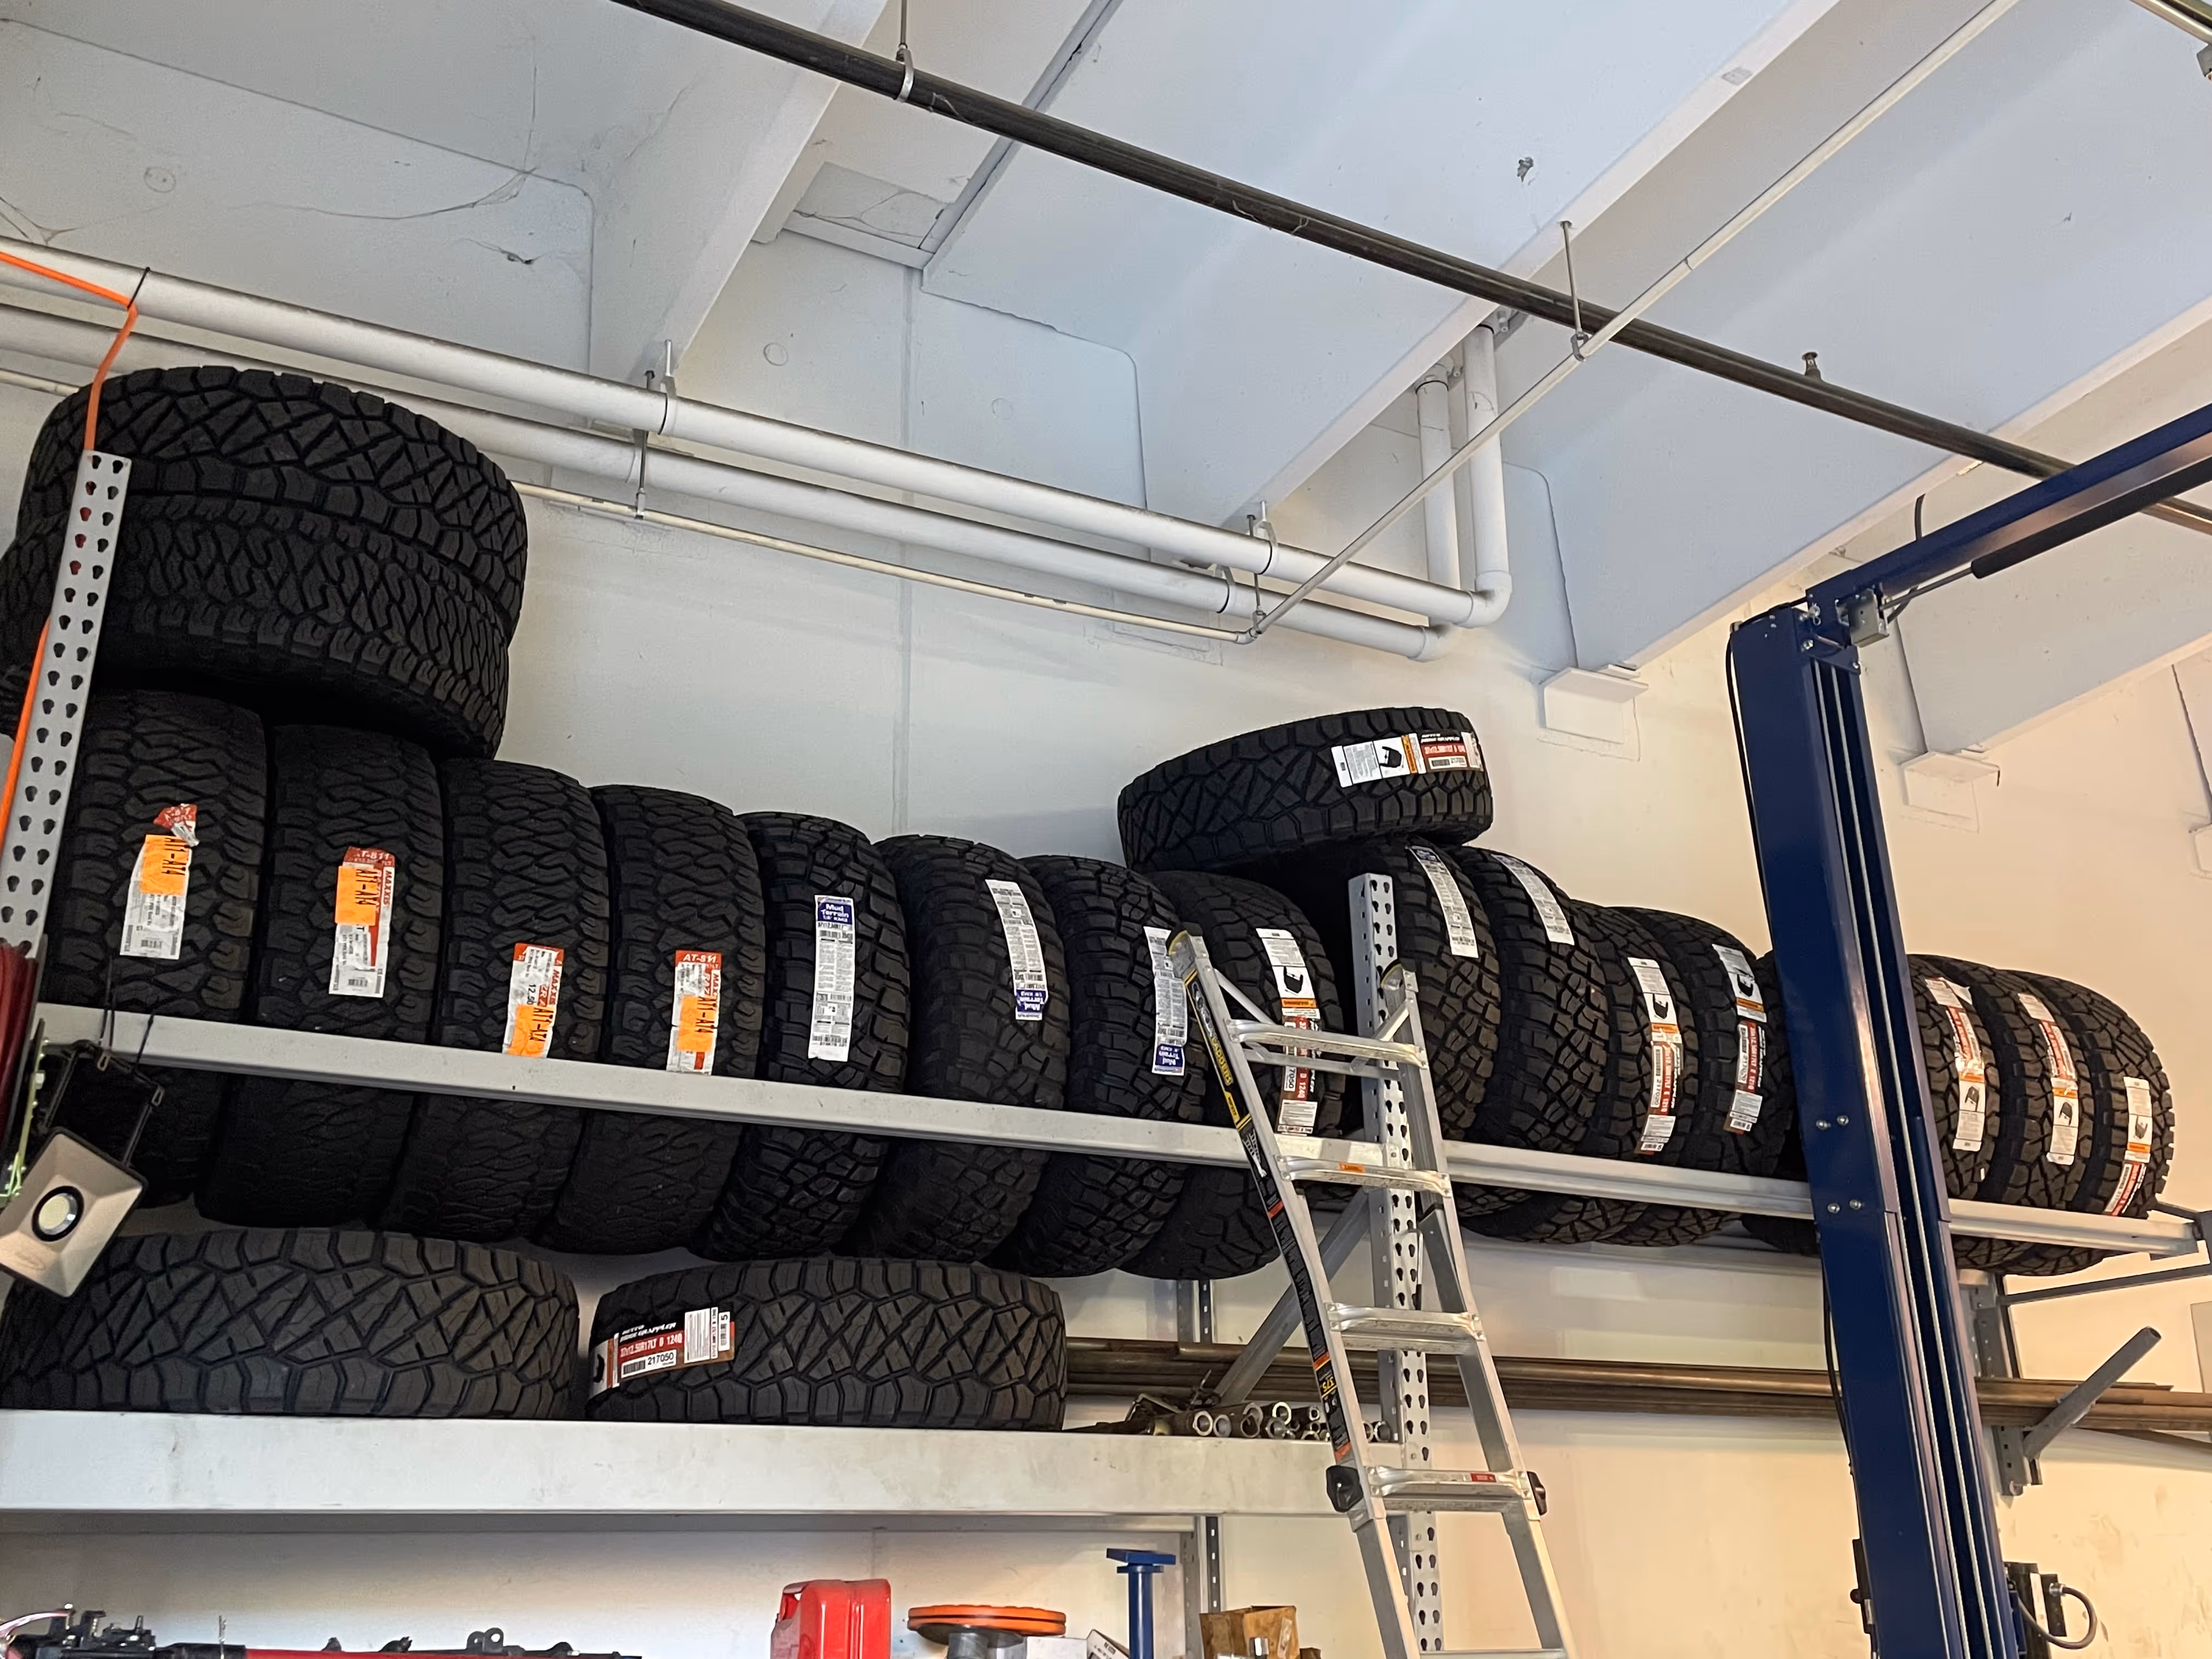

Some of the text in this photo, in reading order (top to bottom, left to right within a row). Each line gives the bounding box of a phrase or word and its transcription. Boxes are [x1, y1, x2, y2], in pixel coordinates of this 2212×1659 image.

[382, 870, 393, 906] MAXXIS
[821, 909, 849, 918] Terrain
[549, 969, 560, 1005] MAXXIS
[1210, 1035, 1232, 1086] LADDERS
[1654, 1079, 1662, 1105] 217020
[647, 1352, 674, 1365] 217050
[1322, 1376, 1335, 1393] 375
